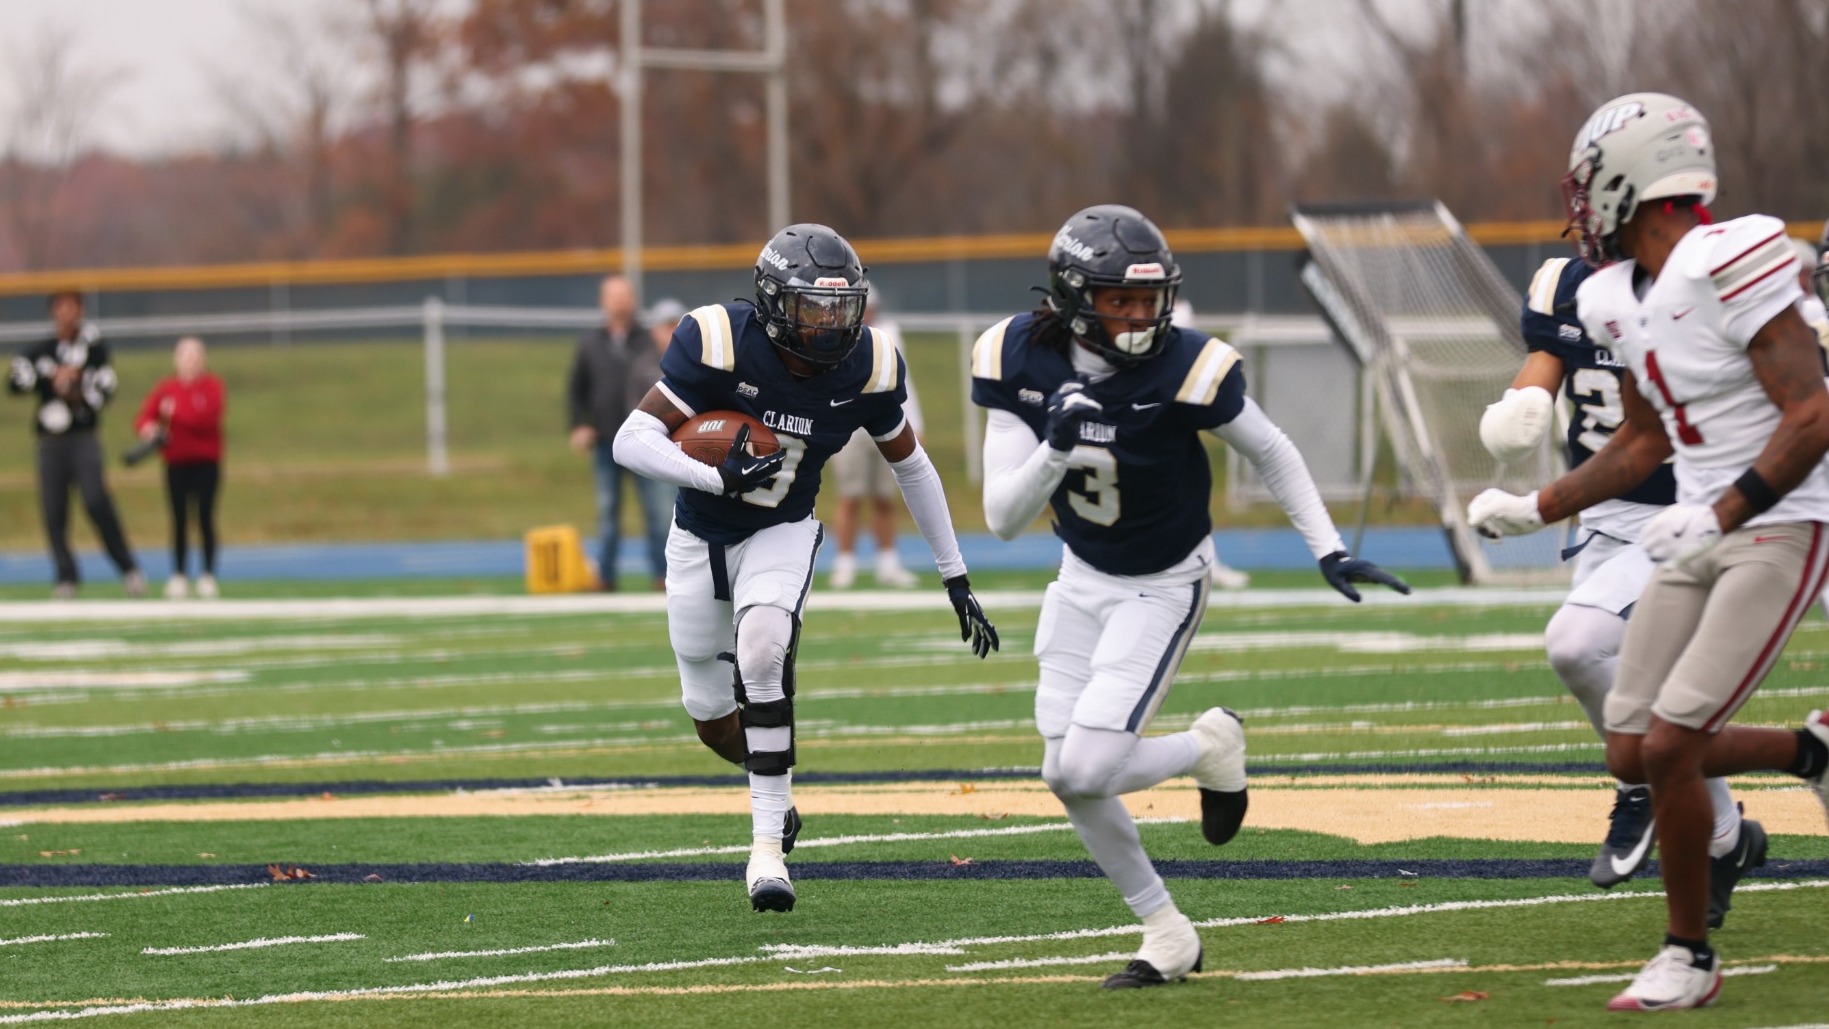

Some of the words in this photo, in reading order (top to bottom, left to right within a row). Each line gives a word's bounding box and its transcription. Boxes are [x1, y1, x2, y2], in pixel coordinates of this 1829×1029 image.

[762, 410, 814, 436] CLARION
[1645, 349, 1705, 446] 1
[1080, 421, 1118, 442] ARION
[1066, 444, 1121, 527] 3
